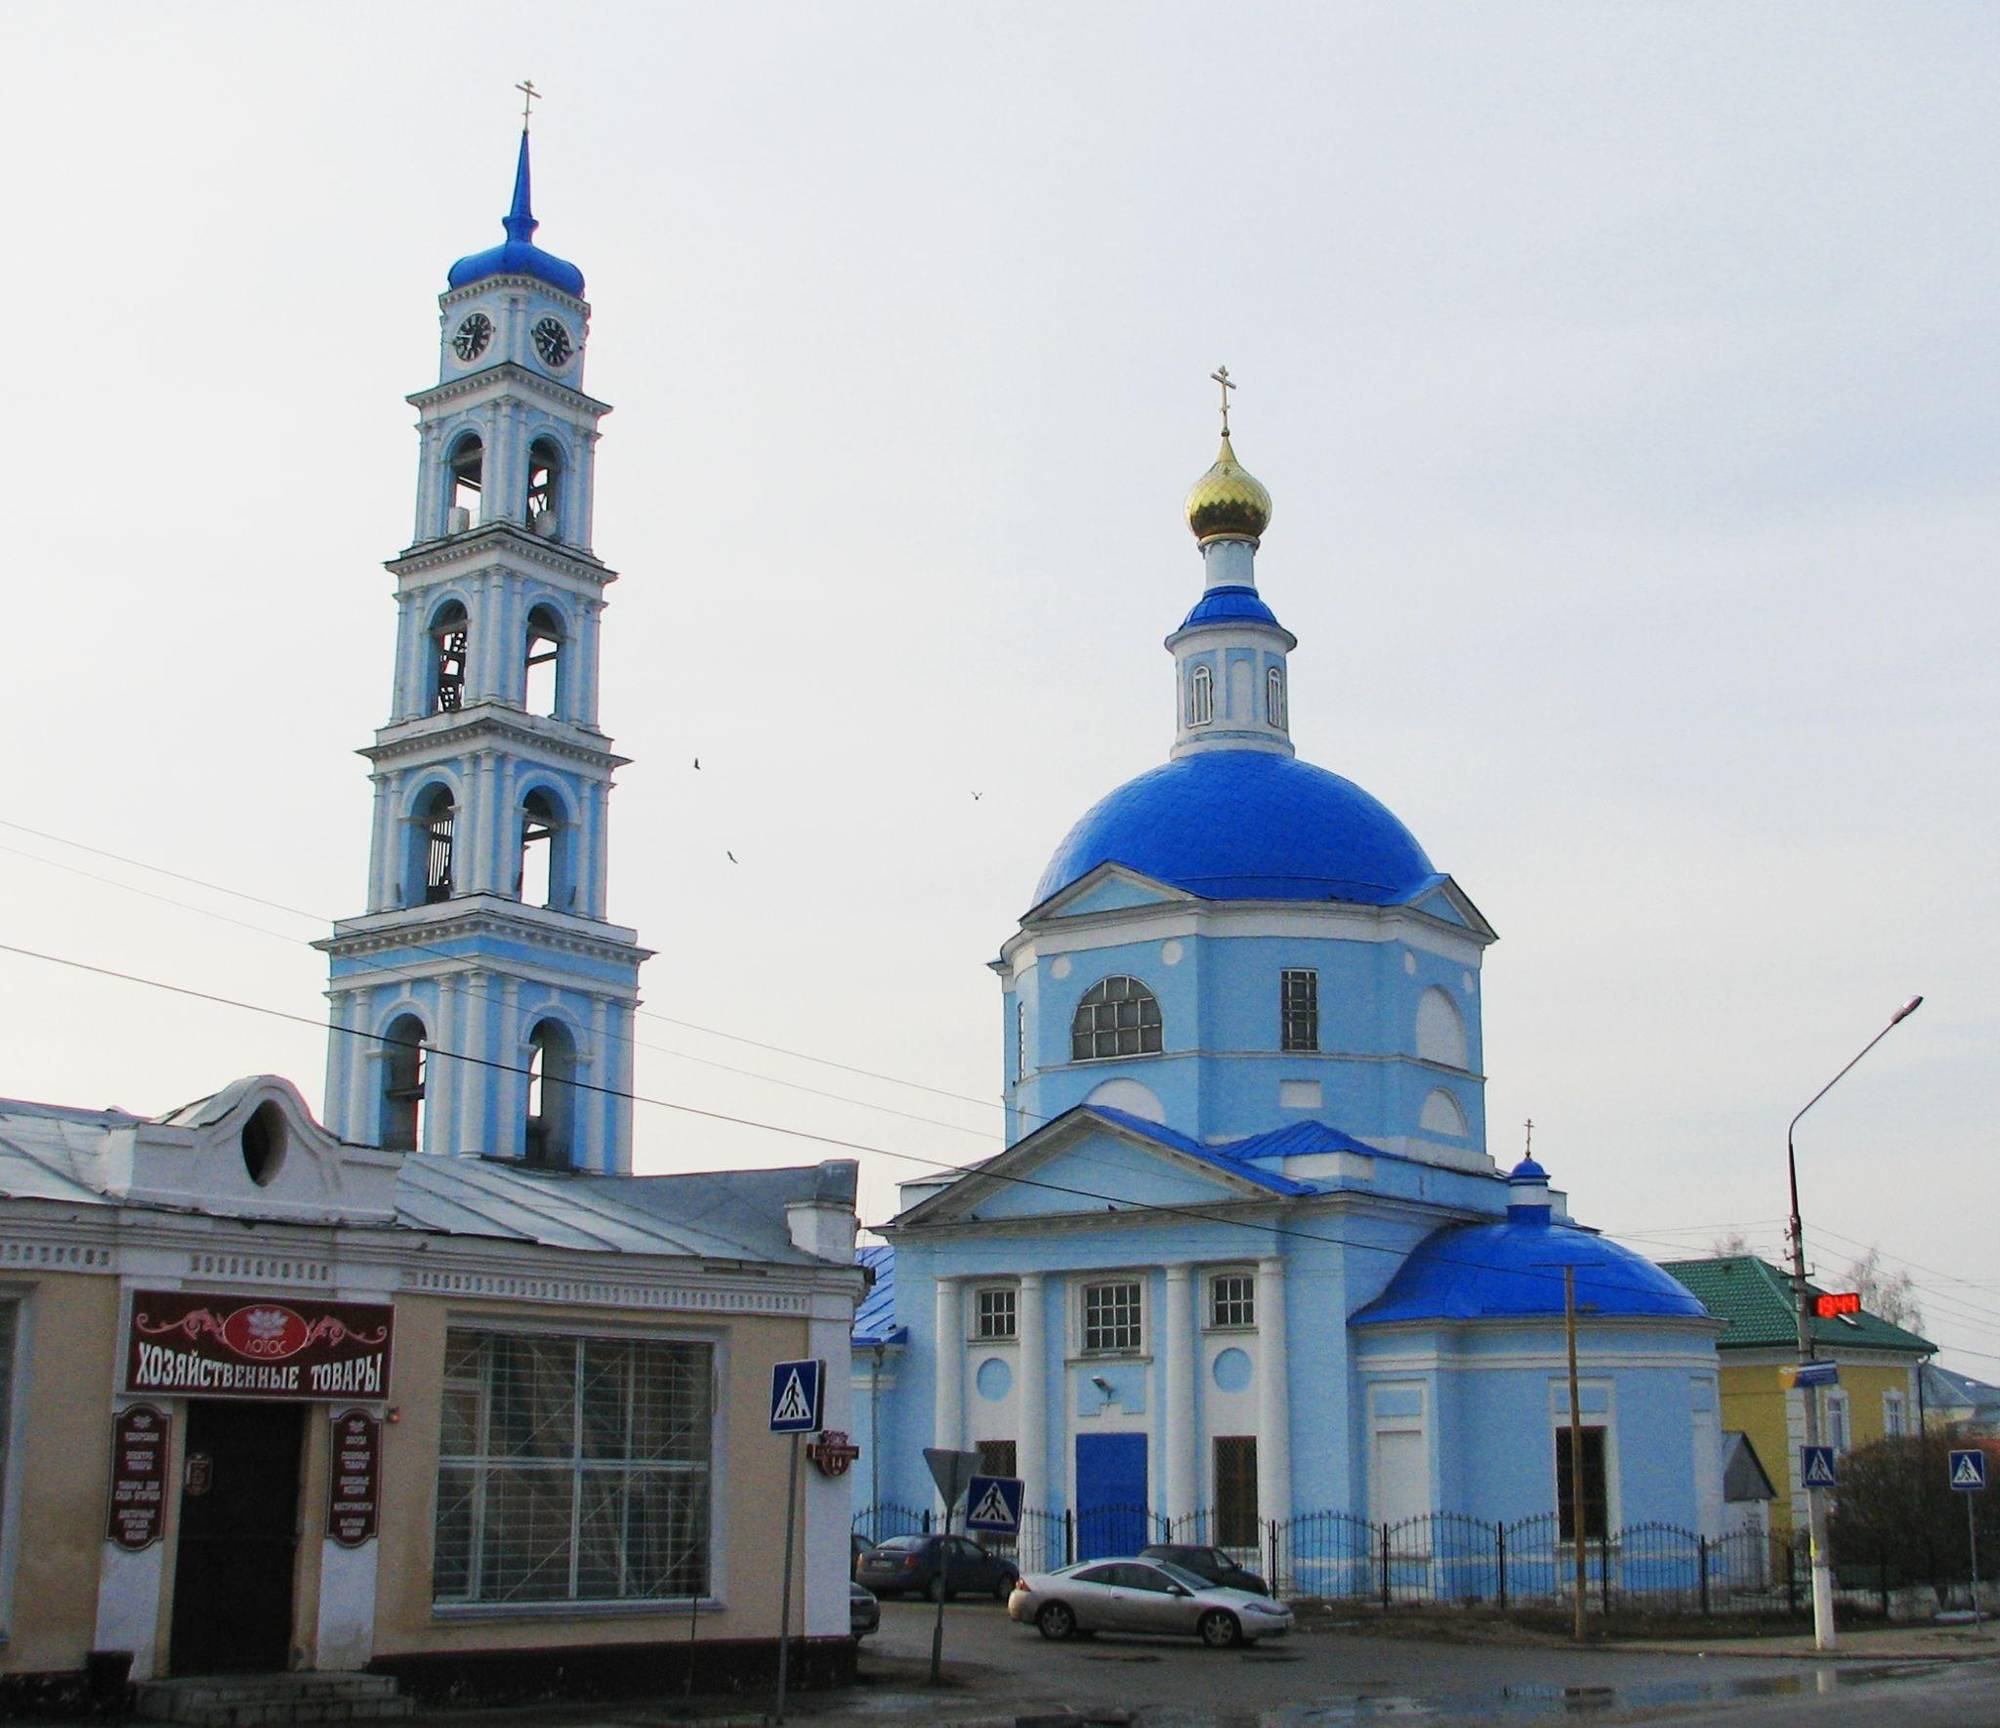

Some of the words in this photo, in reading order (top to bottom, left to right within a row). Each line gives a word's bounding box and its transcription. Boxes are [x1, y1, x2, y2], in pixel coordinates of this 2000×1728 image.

[245, 1339, 287, 1354] ЛОТОС
[135, 1342, 299, 1390] ХОЗЯЙСТВЕННЫЕ
[311, 1353, 384, 1392] ТОВАРЫ
